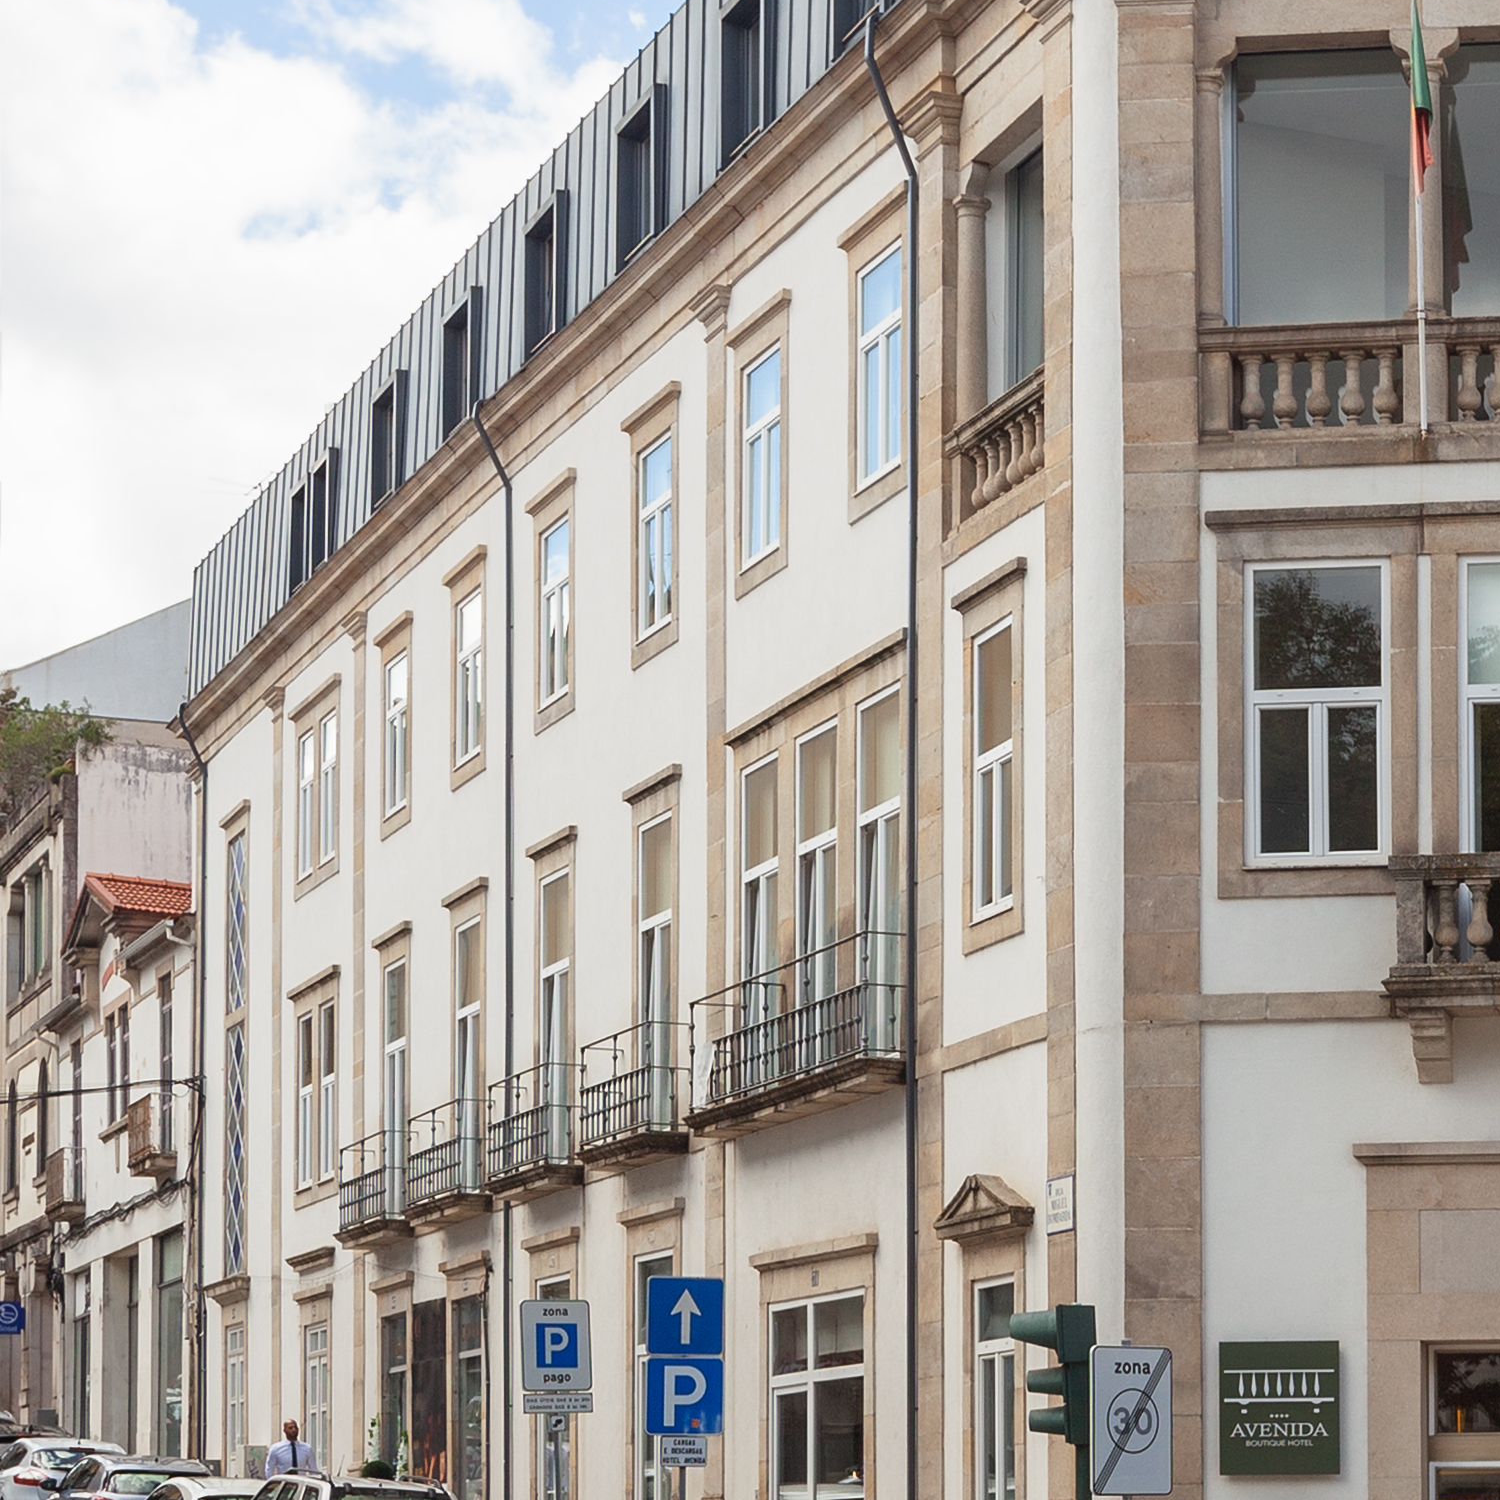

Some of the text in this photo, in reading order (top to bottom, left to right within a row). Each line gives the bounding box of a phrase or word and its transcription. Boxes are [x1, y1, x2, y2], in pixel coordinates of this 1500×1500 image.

[542, 1307, 569, 1317] zona
[544, 1327, 569, 1365] P
[1114, 1361, 1151, 1375] zona
[543, 1373, 571, 1384] pago
[663, 1365, 707, 1427] P
[1113, 1406, 1153, 1436] 30
[1230, 1422, 1329, 1438] AVENIDA
[1245, 1439, 1314, 1447] BOUTIQUE HOTEL
